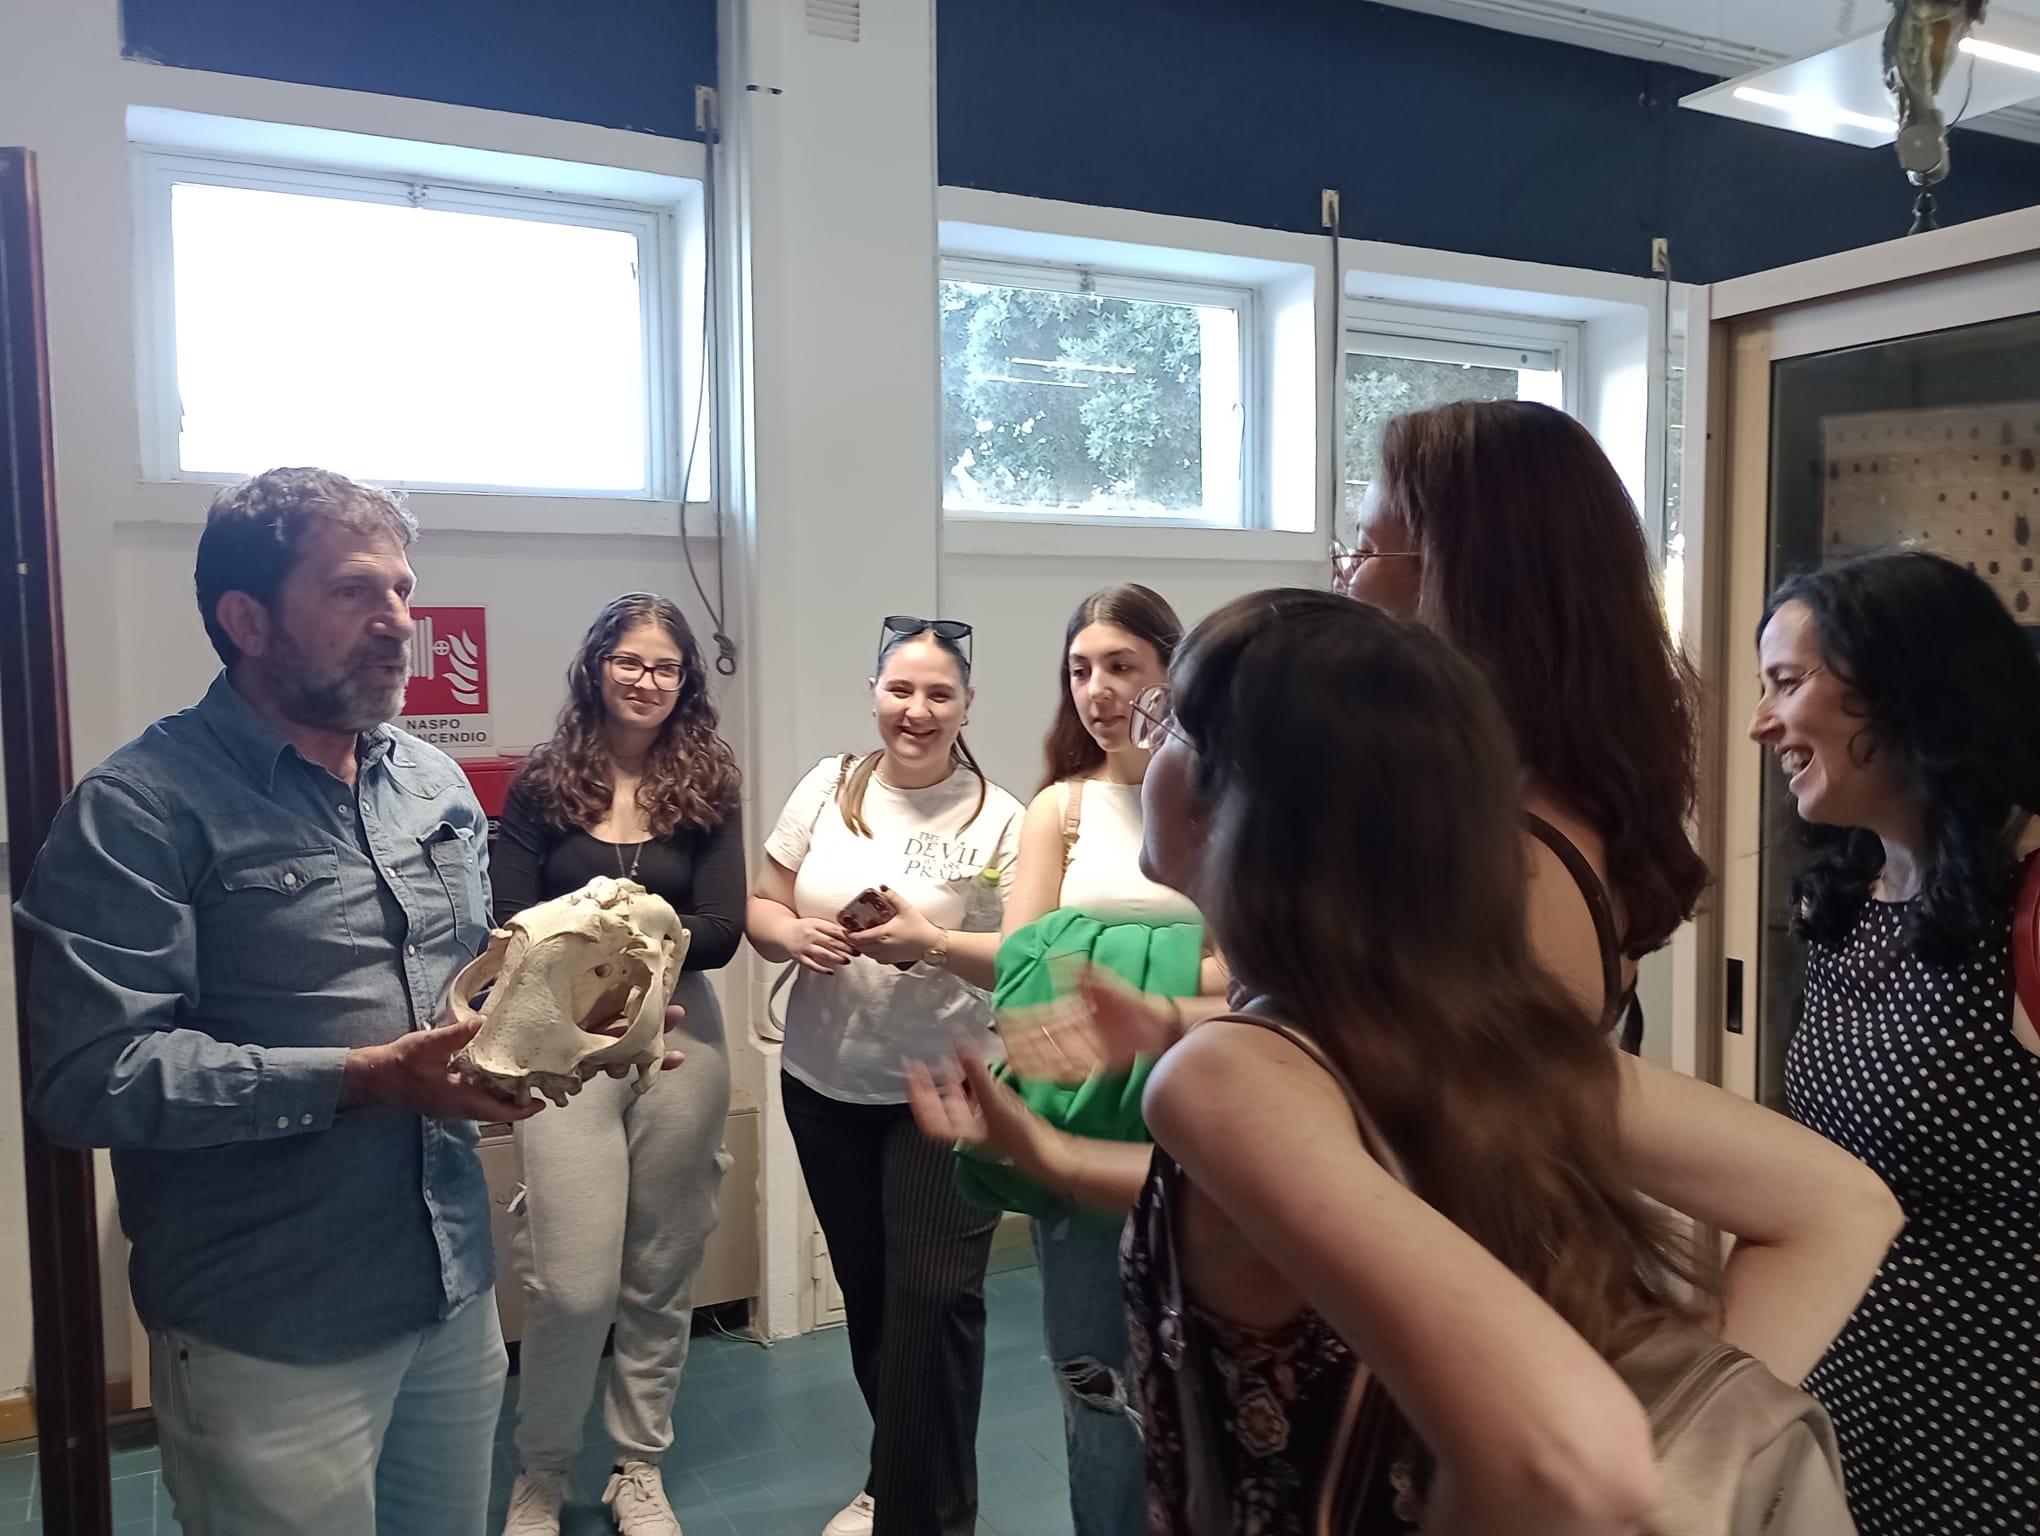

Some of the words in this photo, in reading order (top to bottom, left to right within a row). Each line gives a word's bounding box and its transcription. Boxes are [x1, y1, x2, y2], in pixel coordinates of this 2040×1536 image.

[407, 719, 461, 730] NASPO
[415, 731, 487, 743] NCENDIO
[920, 832, 941, 842] THE
